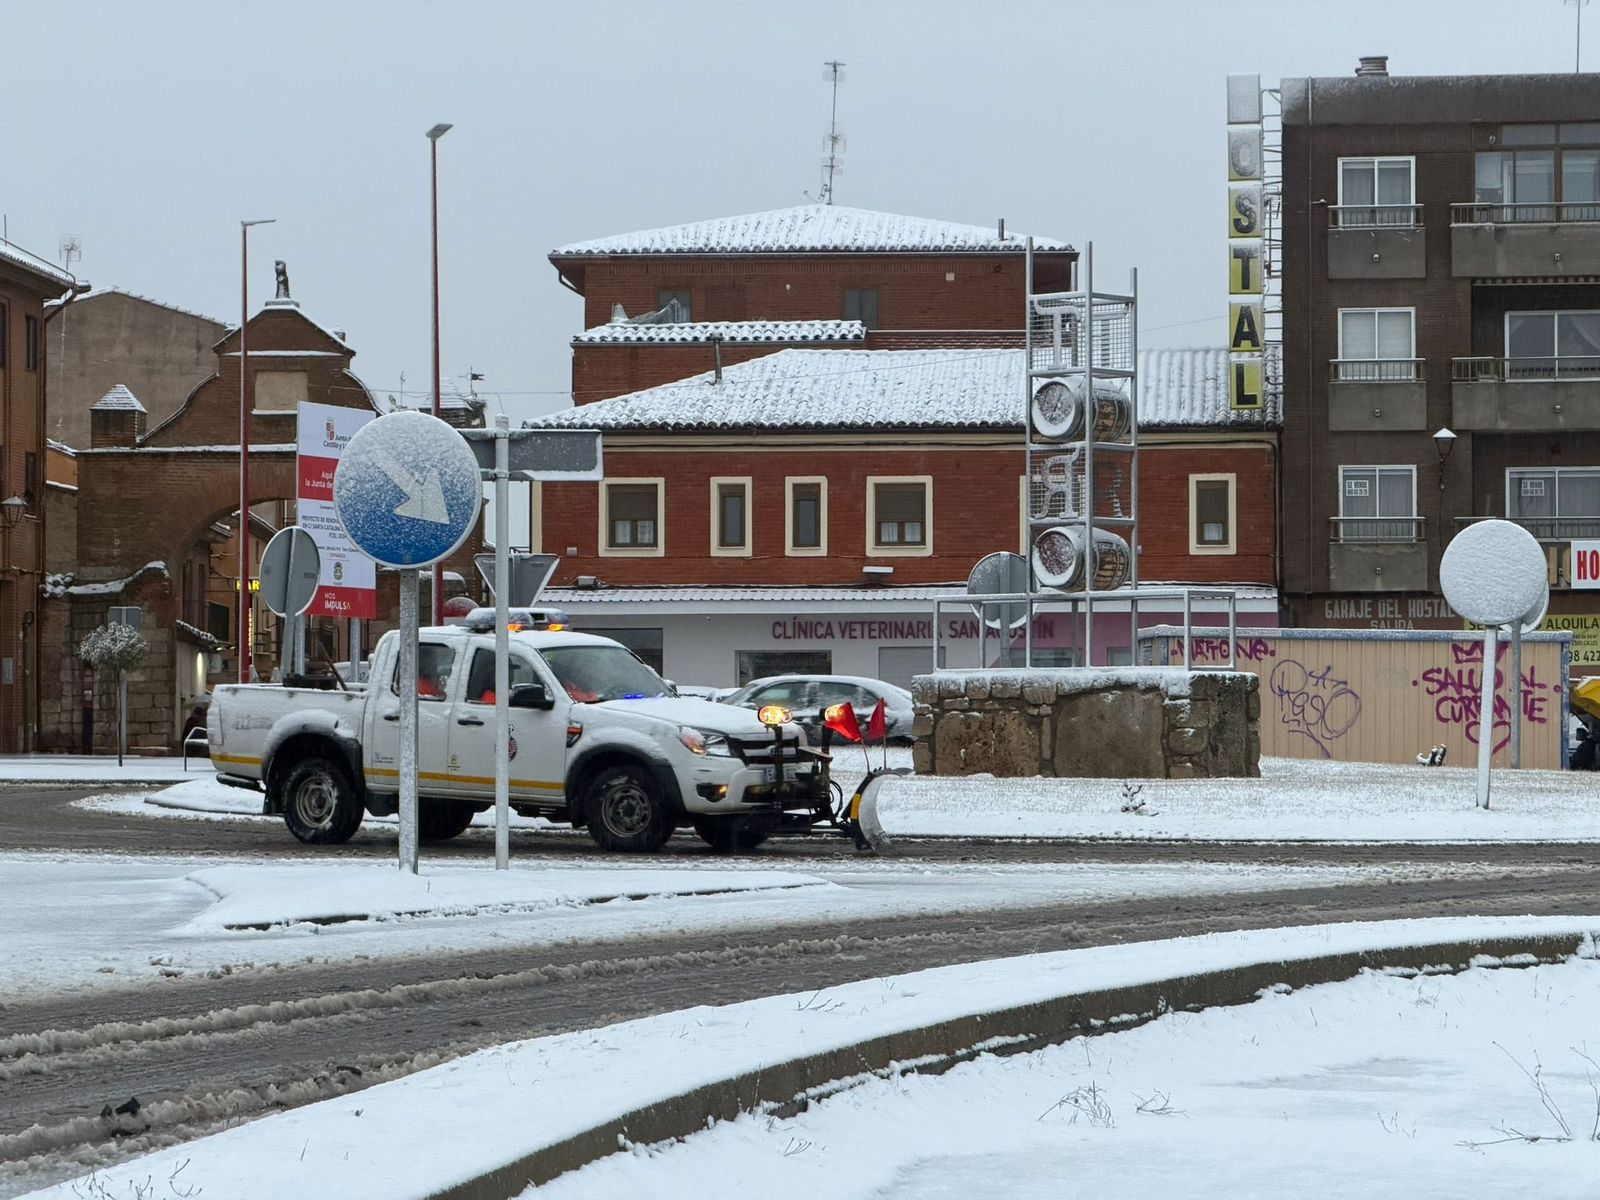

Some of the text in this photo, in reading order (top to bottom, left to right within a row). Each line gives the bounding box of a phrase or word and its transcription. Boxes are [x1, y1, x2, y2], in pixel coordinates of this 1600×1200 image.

[1231, 132, 1261, 406] OSTAL
[311, 479, 326, 488] Junta
[1325, 599, 1456, 618] GARAJE DEL HOSTAL
[772, 615, 835, 640] CLÍNICA
[839, 620, 942, 639] VETERINARI
[949, 620, 980, 639] SAN
[1546, 617, 1600, 630] ALQUILA
